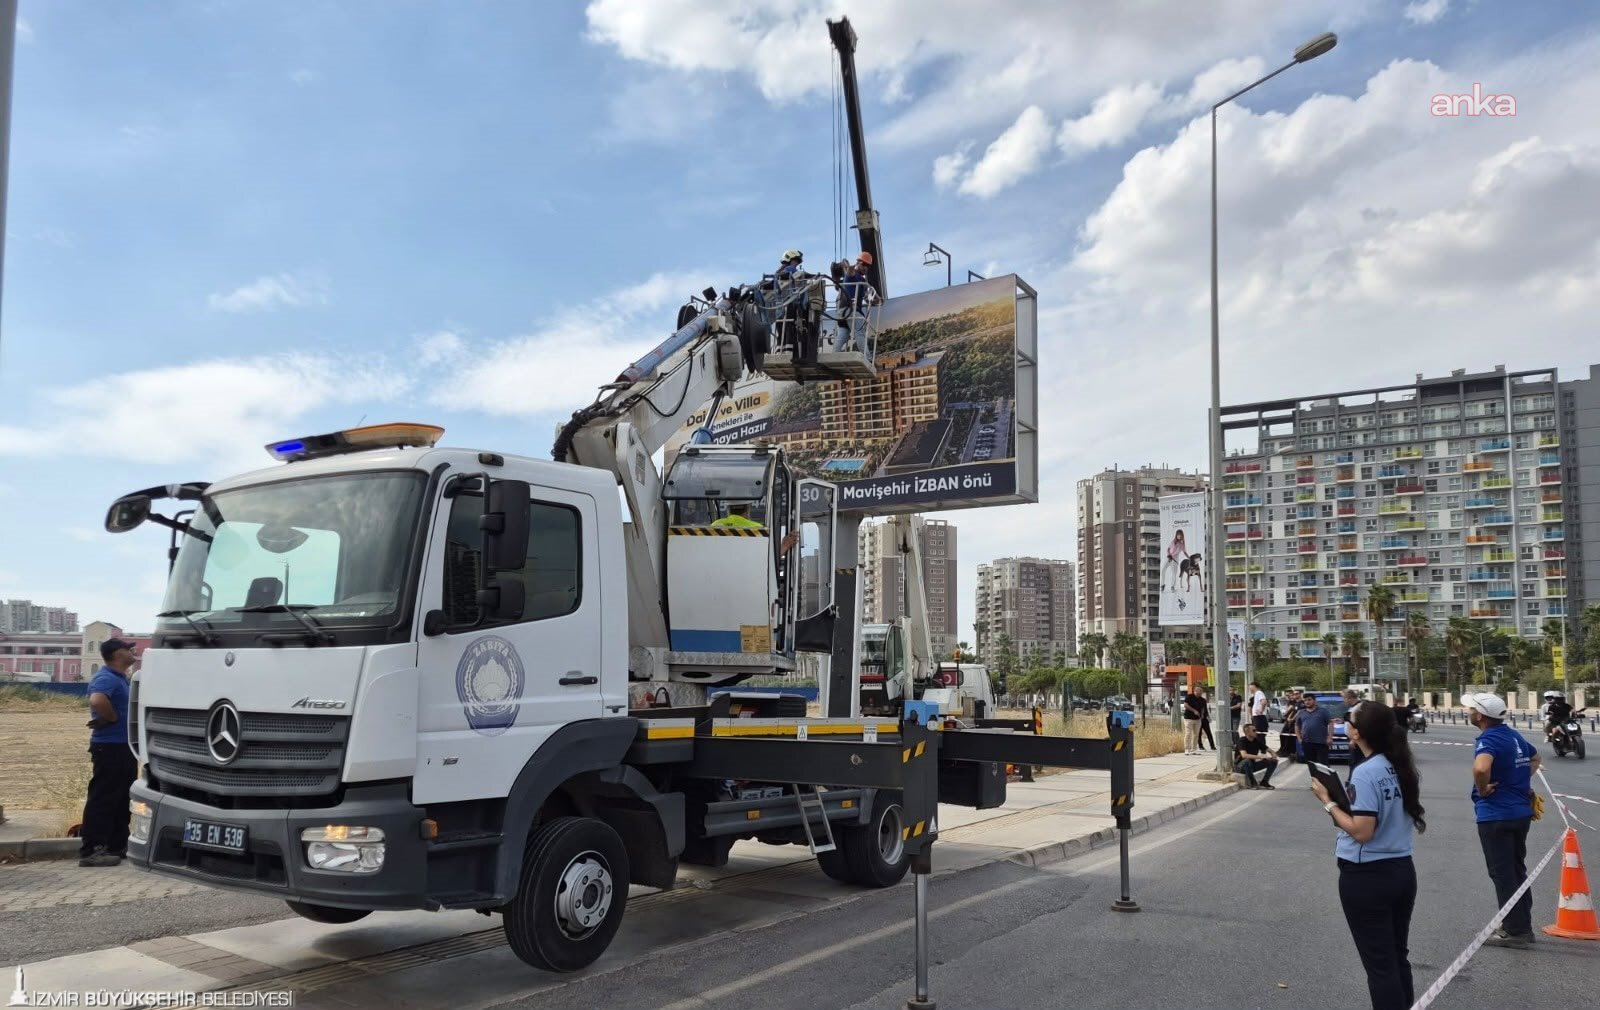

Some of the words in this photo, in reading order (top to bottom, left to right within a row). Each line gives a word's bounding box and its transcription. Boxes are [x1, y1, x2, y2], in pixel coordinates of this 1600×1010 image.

[720, 406, 733, 416] ve
[734, 395, 761, 411] Villa
[740, 422, 768, 438] Hazır
[802, 487, 819, 502] 30
[843, 481, 911, 500] Mavişehir
[914, 476, 959, 494] İZBAN
[962, 473, 992, 489] önü
[473, 640, 510, 657] ZABITA
[190, 823, 202, 842] 35
[207, 825, 220, 844] EN
[224, 827, 243, 847] 538
